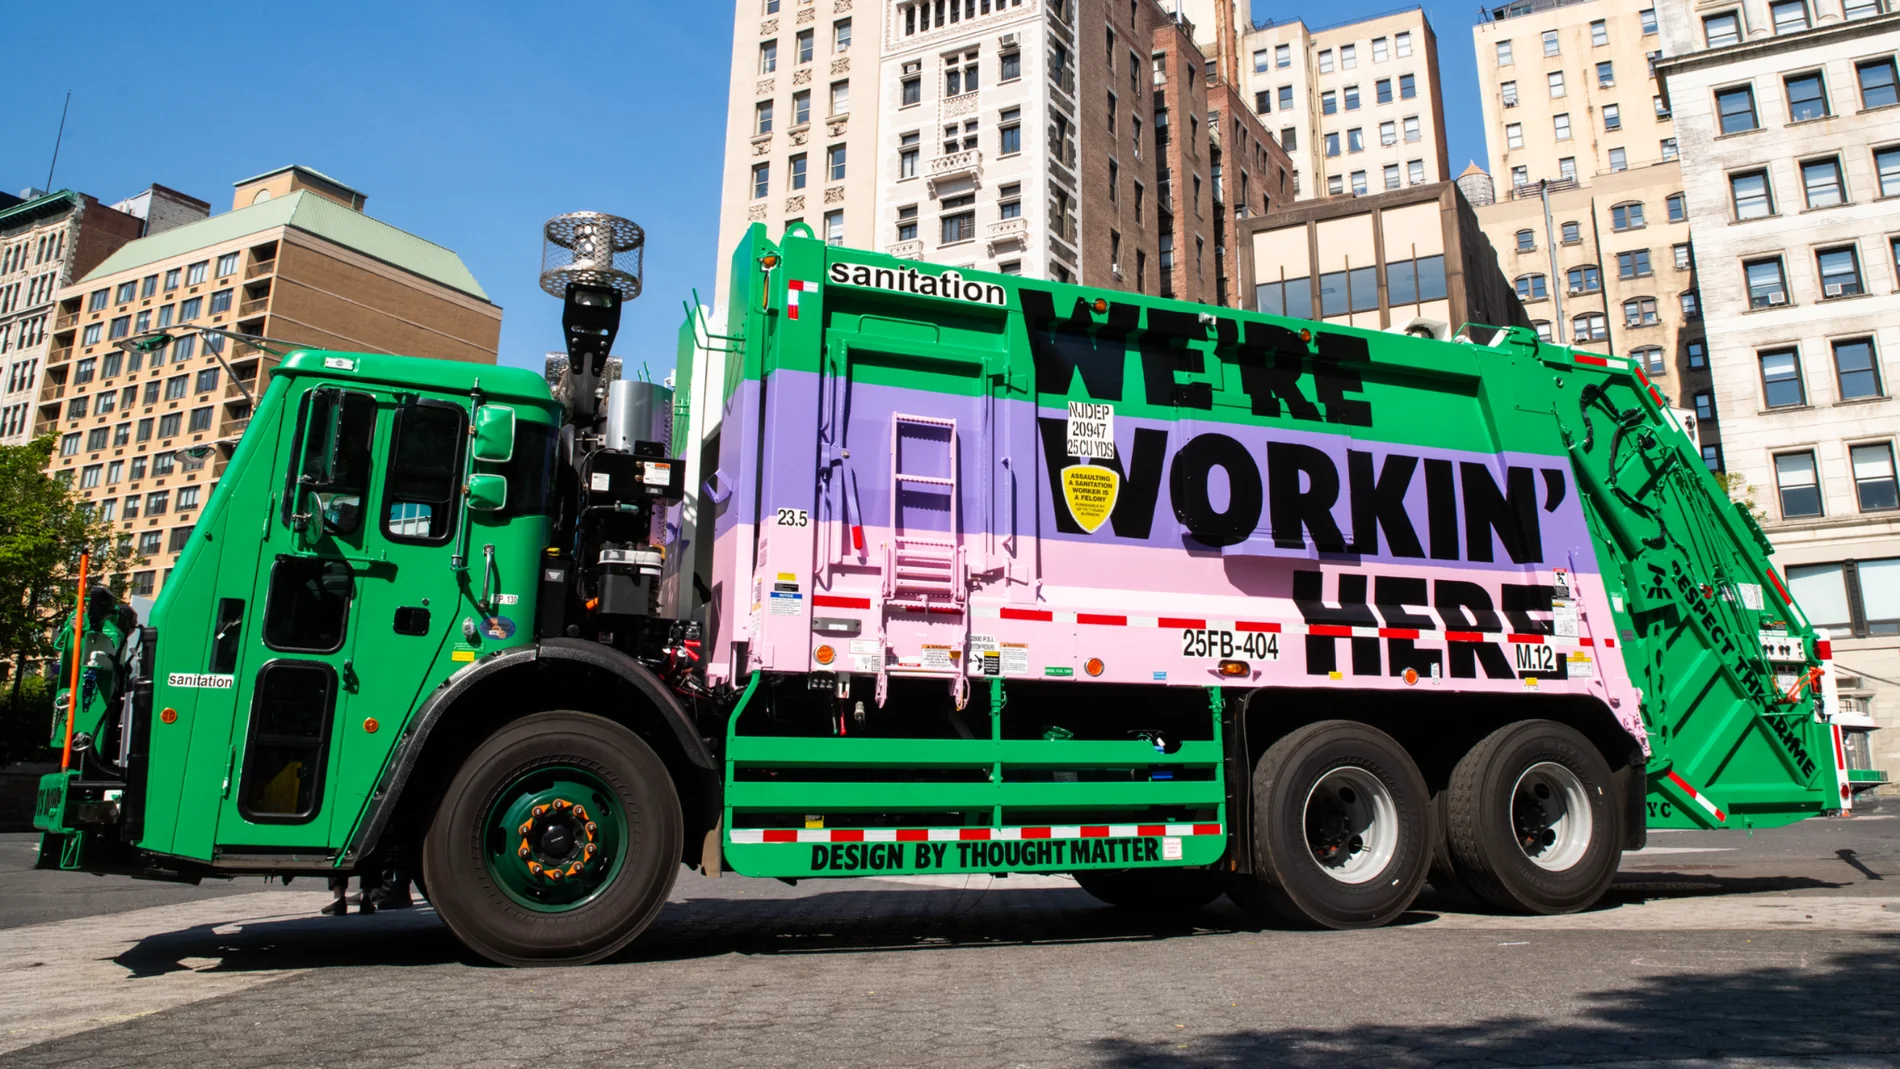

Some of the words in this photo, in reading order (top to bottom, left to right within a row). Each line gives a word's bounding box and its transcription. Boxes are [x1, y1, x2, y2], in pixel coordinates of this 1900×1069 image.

[831, 262, 1004, 305] sanitation
[1018, 288, 1373, 427] WE'RE
[1069, 402, 1110, 420] NJDEP
[1072, 421, 1107, 439] 20947
[1067, 439, 1079, 455] 25
[1080, 439, 1093, 457] CU
[1094, 441, 1113, 458] YDS
[1070, 473, 1111, 482] ASSAULTING
[1075, 480, 1113, 489] SANITATION
[1037, 417, 1566, 565] WORKIN'
[1072, 487, 1101, 496] WORKER
[777, 509, 808, 527] 23.5
[1671, 559, 1735, 655] RESPECT
[1293, 570, 1568, 680] HERE
[1183, 629, 1279, 660] 25FB-404
[1516, 644, 1554, 670] M.12
[168, 674, 233, 688] sanitation
[811, 843, 904, 870] DESIGN
[915, 843, 947, 869] BY
